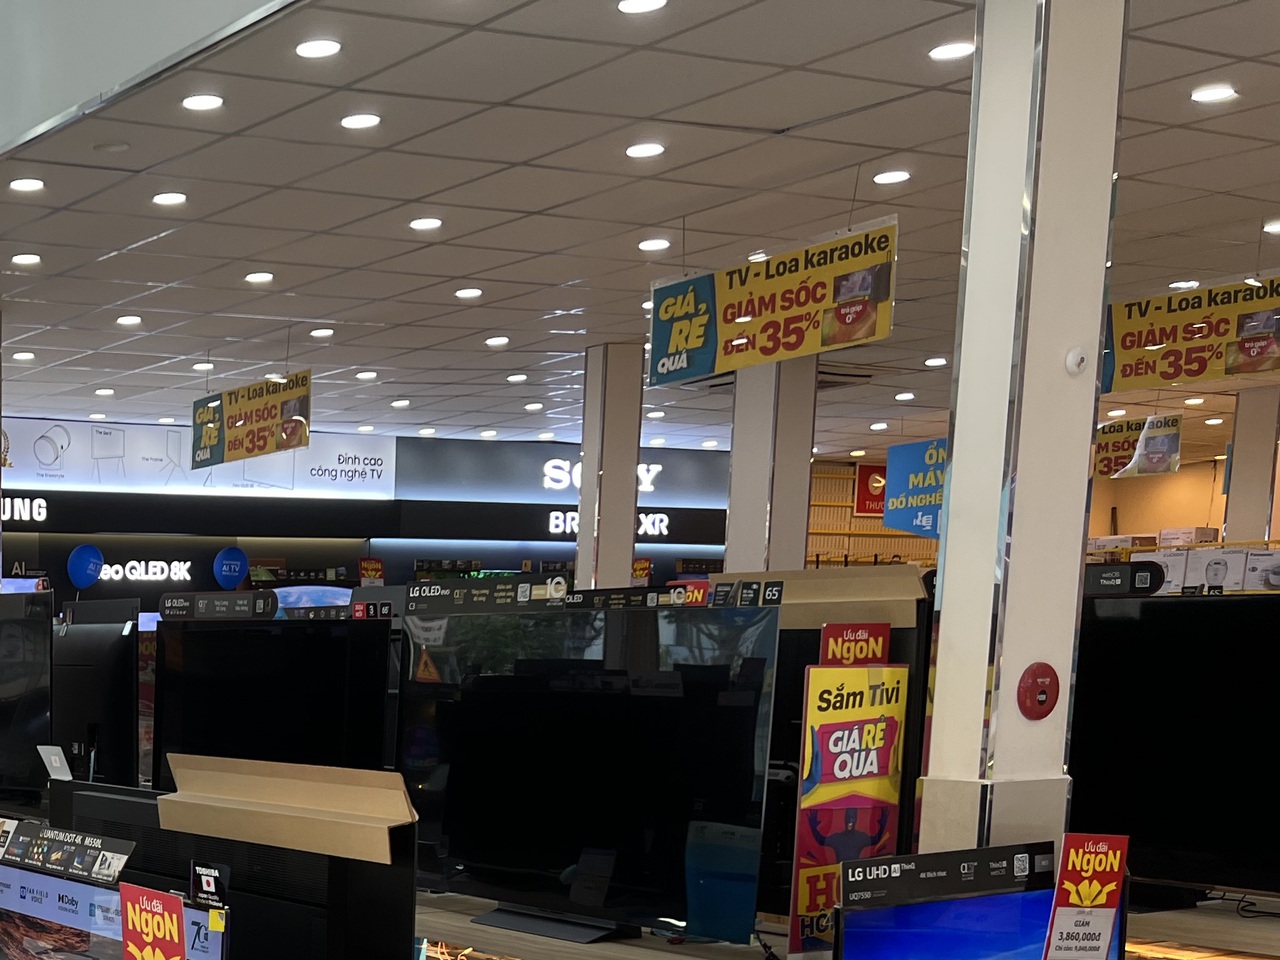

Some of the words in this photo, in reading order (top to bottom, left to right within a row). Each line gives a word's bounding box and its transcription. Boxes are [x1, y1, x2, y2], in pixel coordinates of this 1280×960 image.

[726, 266, 750, 290] TV
[765, 258, 799, 281] Loa
[804, 233, 889, 271] karaoke
[659, 286, 696, 321] GIÁ
[723, 290, 776, 324] GIẢM
[780, 276, 827, 308] SỐC
[1125, 300, 1151, 320] TV
[1167, 295, 1202, 313] Loa
[723, 329, 756, 357] ĐẾN
[759, 310, 820, 357] 35%
[1121, 323, 1178, 350] GIẢM
[1182, 313, 1231, 342] SỐC
[657, 349, 688, 375] QUÁ
[1121, 356, 1157, 378] ĐẾN
[1159, 342, 1223, 380] 35%
[228, 392, 240, 405] TV
[247, 385, 265, 400] Loa
[265, 374, 308, 395] karaoke
[254, 403, 278, 421] SỐC
[1101, 423, 1123, 435] Loa
[1127, 417, 1178, 432] karaoke
[227, 437, 244, 452] ĐẾN
[245, 424, 275, 454] 35%
[338, 453, 360, 466] Đỉnh
[363, 457, 383, 466] cao
[340, 468, 367, 482] nghệ
[369, 469, 382, 480] TV
[638, 513, 669, 535] XR
[12, 561, 25, 575] AI
[125, 561, 169, 580] QLED
[170, 561, 191, 580] 8K
[409, 587, 419, 597] LG
[421, 586, 440, 597] OLED
[565, 595, 583, 603] OLED
[828, 637, 883, 664] NgoN
[817, 683, 864, 712] Sắm
[869, 680, 900, 706] Tivi
[828, 725, 860, 753] GIÁ
[861, 714, 887, 749] RẺ
[833, 749, 879, 780] QUÁ
[40, 828, 64, 842] QUANTUM
[64, 833, 75, 843] DOT
[75, 835, 82, 844] 4K
[195, 866, 219, 878] TOSHIBA
[848, 868, 863, 881] LG
[867, 865, 889, 879] UHD
[1067, 848, 1121, 878] NgoN
[26, 887, 35, 896] FAR
[35, 889, 49, 899] FIELD
[140, 895, 151, 910] Ưu
[151, 899, 163, 914] đãi
[126, 901, 179, 943] NgoN
[1074, 918, 1090, 928] GIẢM
[1058, 931, 1101, 943] 3,860,000đ
